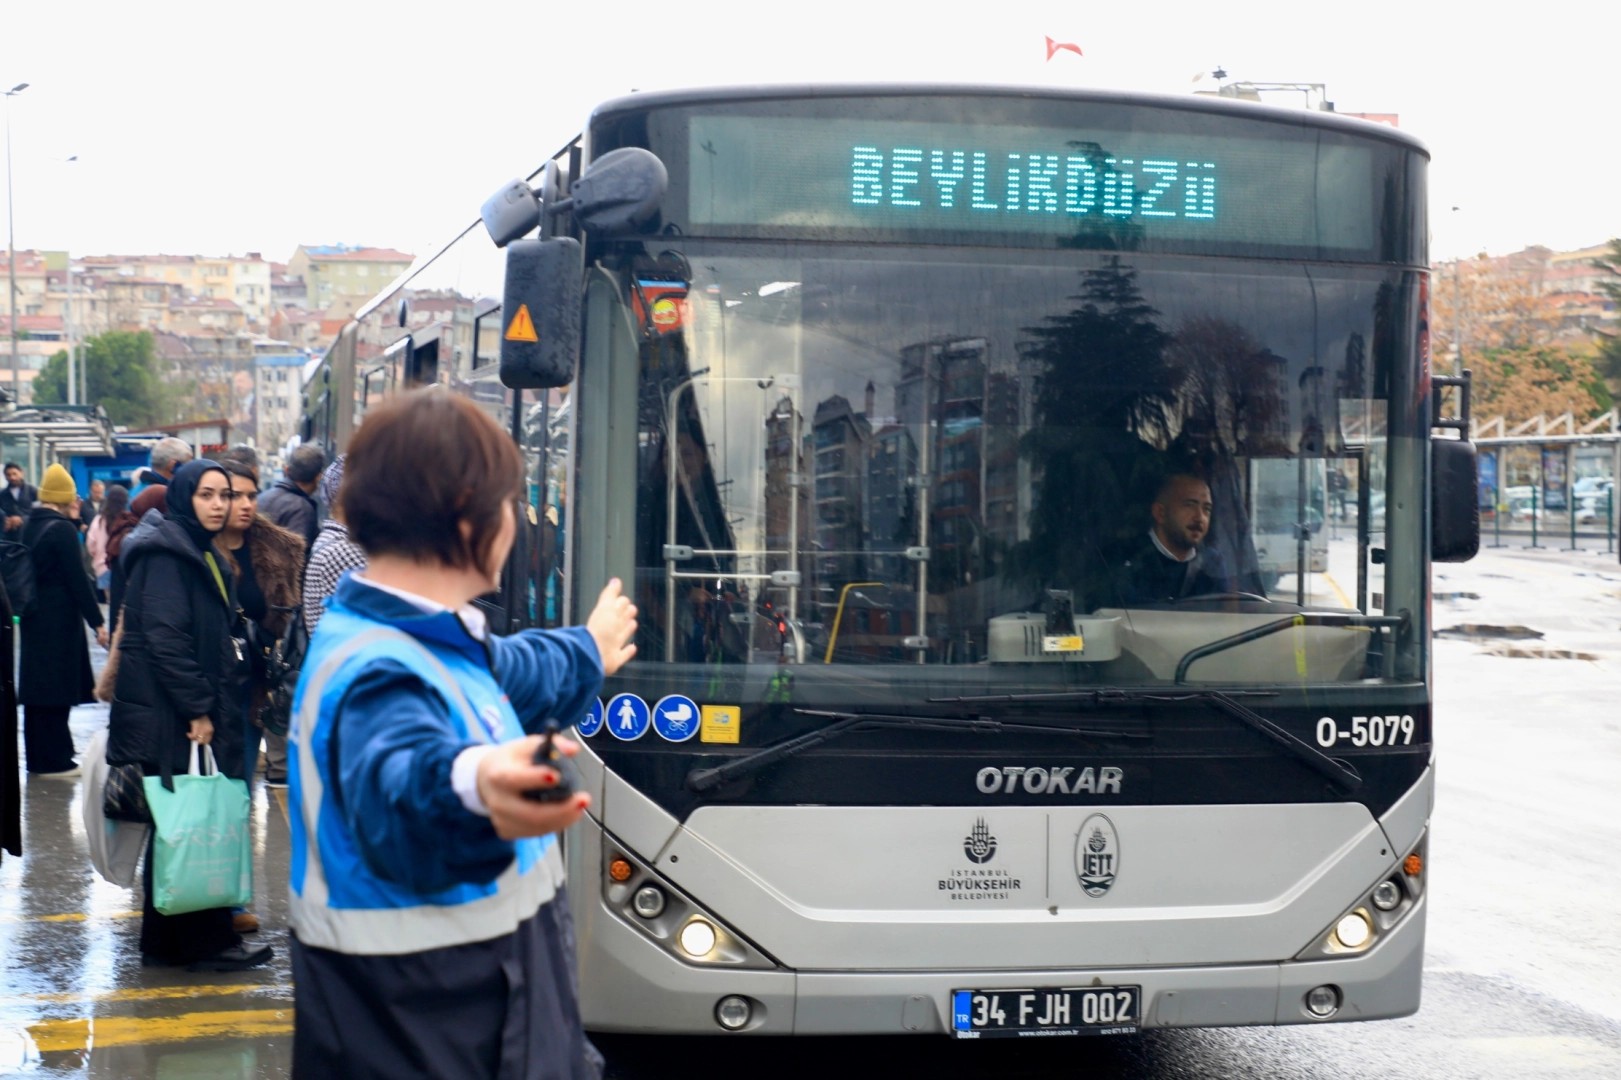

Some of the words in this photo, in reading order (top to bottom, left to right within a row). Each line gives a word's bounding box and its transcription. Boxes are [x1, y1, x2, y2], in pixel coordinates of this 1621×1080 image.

[852, 147, 1215, 218] BEYLİKDÜZÜ
[1316, 715, 1415, 748] O-5079
[975, 766, 1124, 794] OTOKAR
[951, 869, 1009, 877] İSTANBUL
[938, 877, 1021, 891] BÜYÜKŞEHİR
[951, 891, 1009, 900] BELEDİYESİ
[956, 1013, 969, 1023] TR
[972, 995, 1006, 1026] 34
[1018, 993, 1071, 1025] FJH
[1082, 991, 1132, 1024] 002
